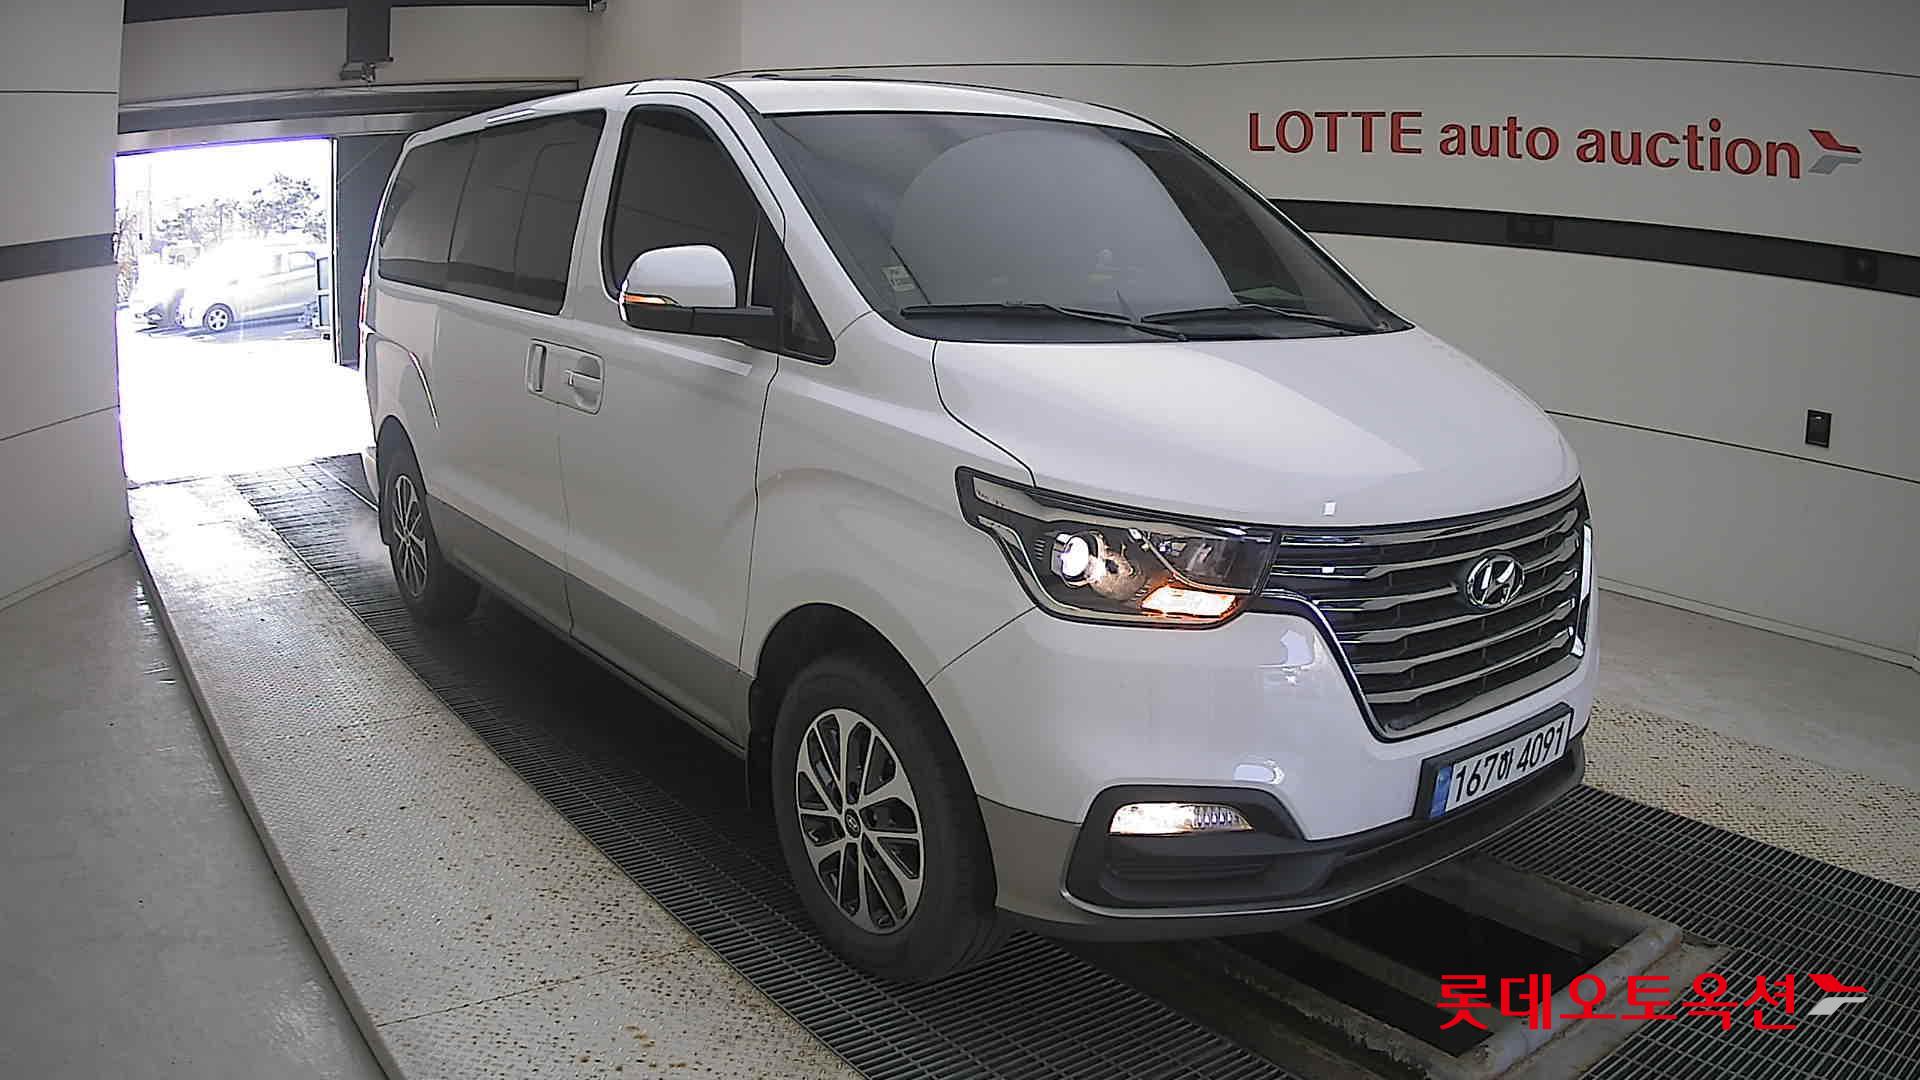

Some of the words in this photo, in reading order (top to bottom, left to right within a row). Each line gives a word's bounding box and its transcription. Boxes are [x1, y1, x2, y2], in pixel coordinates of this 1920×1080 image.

[1248, 110, 1423, 154] LOTTE
[1438, 116, 1560, 160] auto
[1576, 118, 1801, 179] auction
[1516, 721, 1565, 773] 4091
